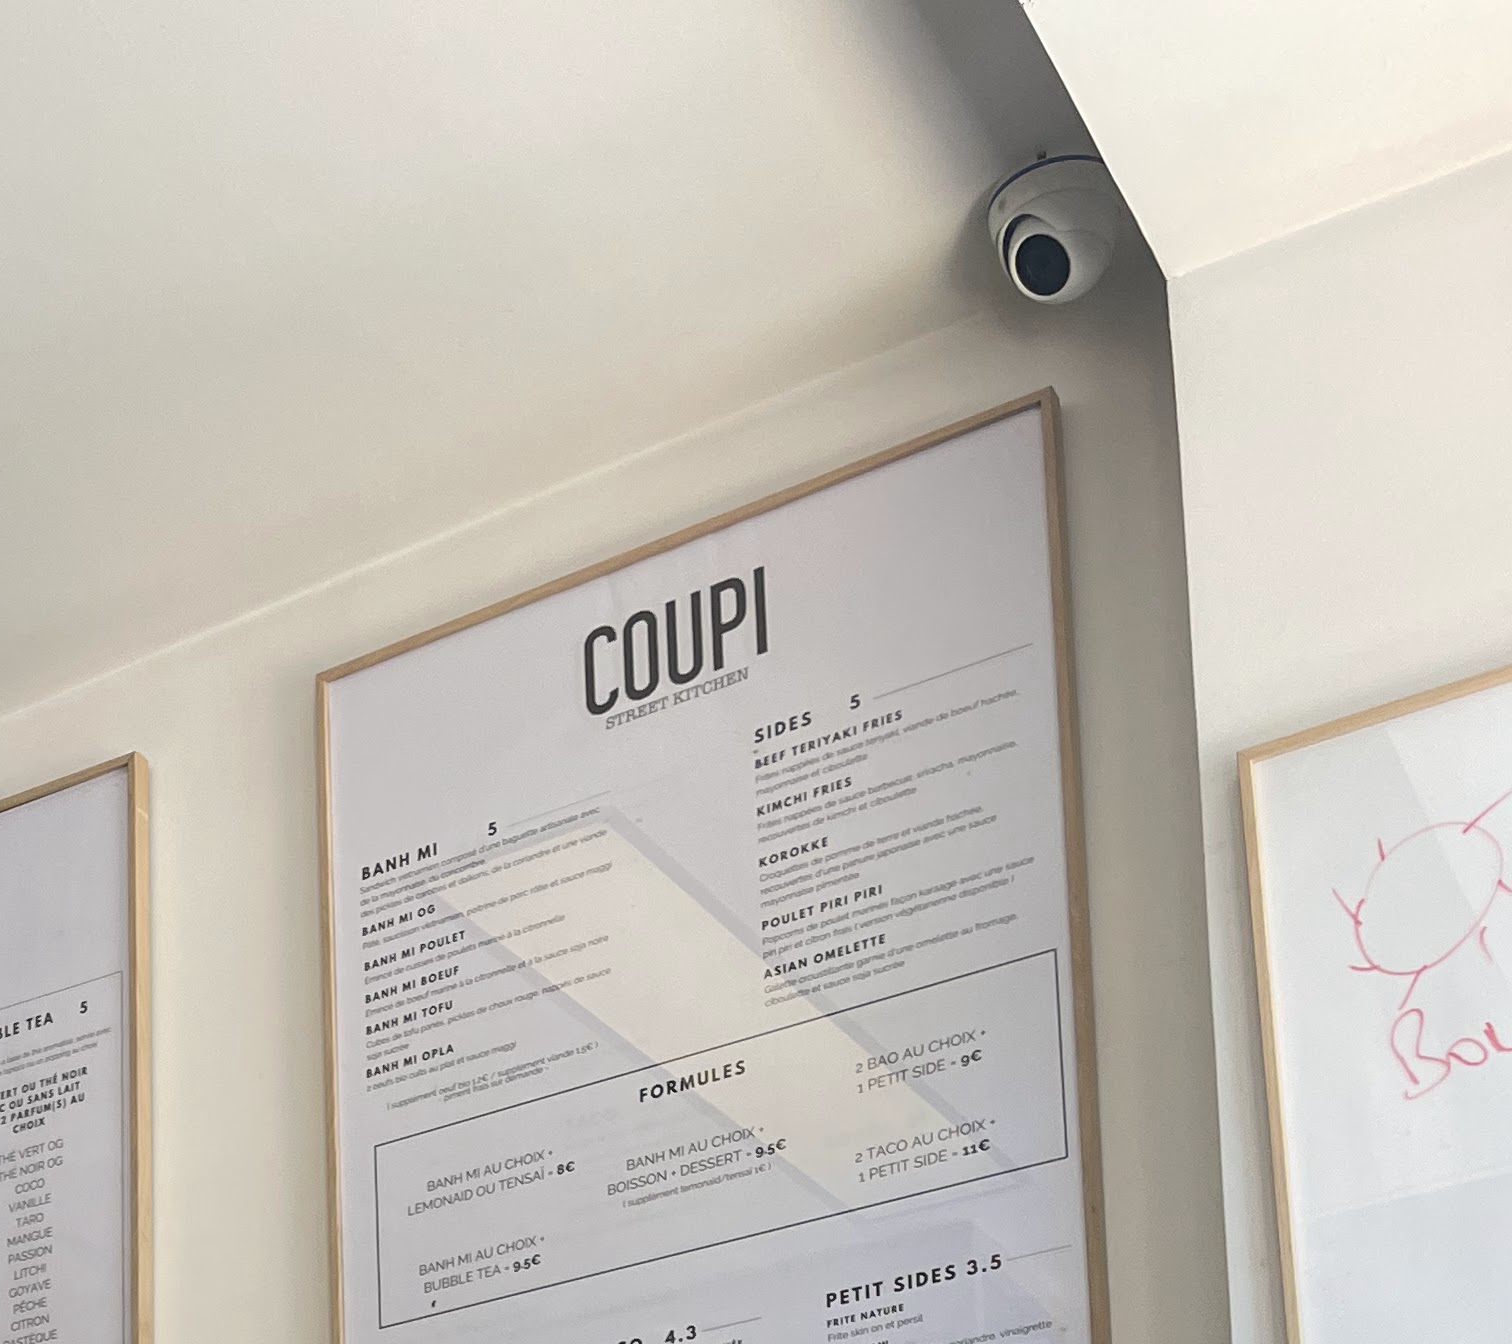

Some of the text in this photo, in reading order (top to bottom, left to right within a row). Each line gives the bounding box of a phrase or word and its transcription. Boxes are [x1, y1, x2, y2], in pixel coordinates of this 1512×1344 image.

[585, 566, 768, 715] COUPI
[605, 667, 749, 729] STREET KITCHEN
[754, 695, 861, 743] SIDES 5
[754, 710, 903, 769] BEEF TERIYAKI FRIES
[756, 777, 852, 817] KIMCHI FRIES
[361, 822, 497, 881] BANH MI 5
[759, 837, 828, 867] KOROKKE
[362, 905, 436, 936] BANH MI OG
[762, 885, 882, 930] POULET PIRI PIRI
[364, 931, 466, 971] BANH MI POULET
[764, 934, 886, 979] ASIAN OMELETTE
[365, 966, 459, 1003] BANH MI BOEUF
[26, 1013, 53, 1031] TEA
[80, 1001, 88, 1014] 5
[366, 1001, 453, 1035] BANH MI TOFU
[366, 1045, 454, 1078] BANH MI OPLA
[22, 1082, 36, 1094] OU
[40, 1072, 57, 1089] THÉ
[62, 1067, 87, 1082] NOIR
[639, 1061, 746, 1102] FORMULES
[855, 1153, 863, 1163] 2
[867, 1139, 908, 1160] TACO
[912, 1132, 933, 1148] AU
[938, 1119, 986, 1141] CHOIX
[859, 1173, 865, 1183] 1
[869, 1159, 909, 1179] PETIT
[914, 1150, 947, 1169] SIDE
[962, 1139, 991, 1156] 11€
[8, 1193, 51, 1212] VANILLE
[15, 1178, 45, 1194] COCO
[7, 1227, 53, 1247] MANGUE
[9, 1279, 51, 1298] GOYAVE
[826, 1254, 1002, 1308] PETIT SIDES 3.5
[664, 1325, 697, 1344] 4.3
[827, 1304, 904, 1328] FRITE NATURE
[828, 1332, 848, 1342] Frite
[871, 1325, 883, 1333] on
[897, 1314, 924, 1328] persil
